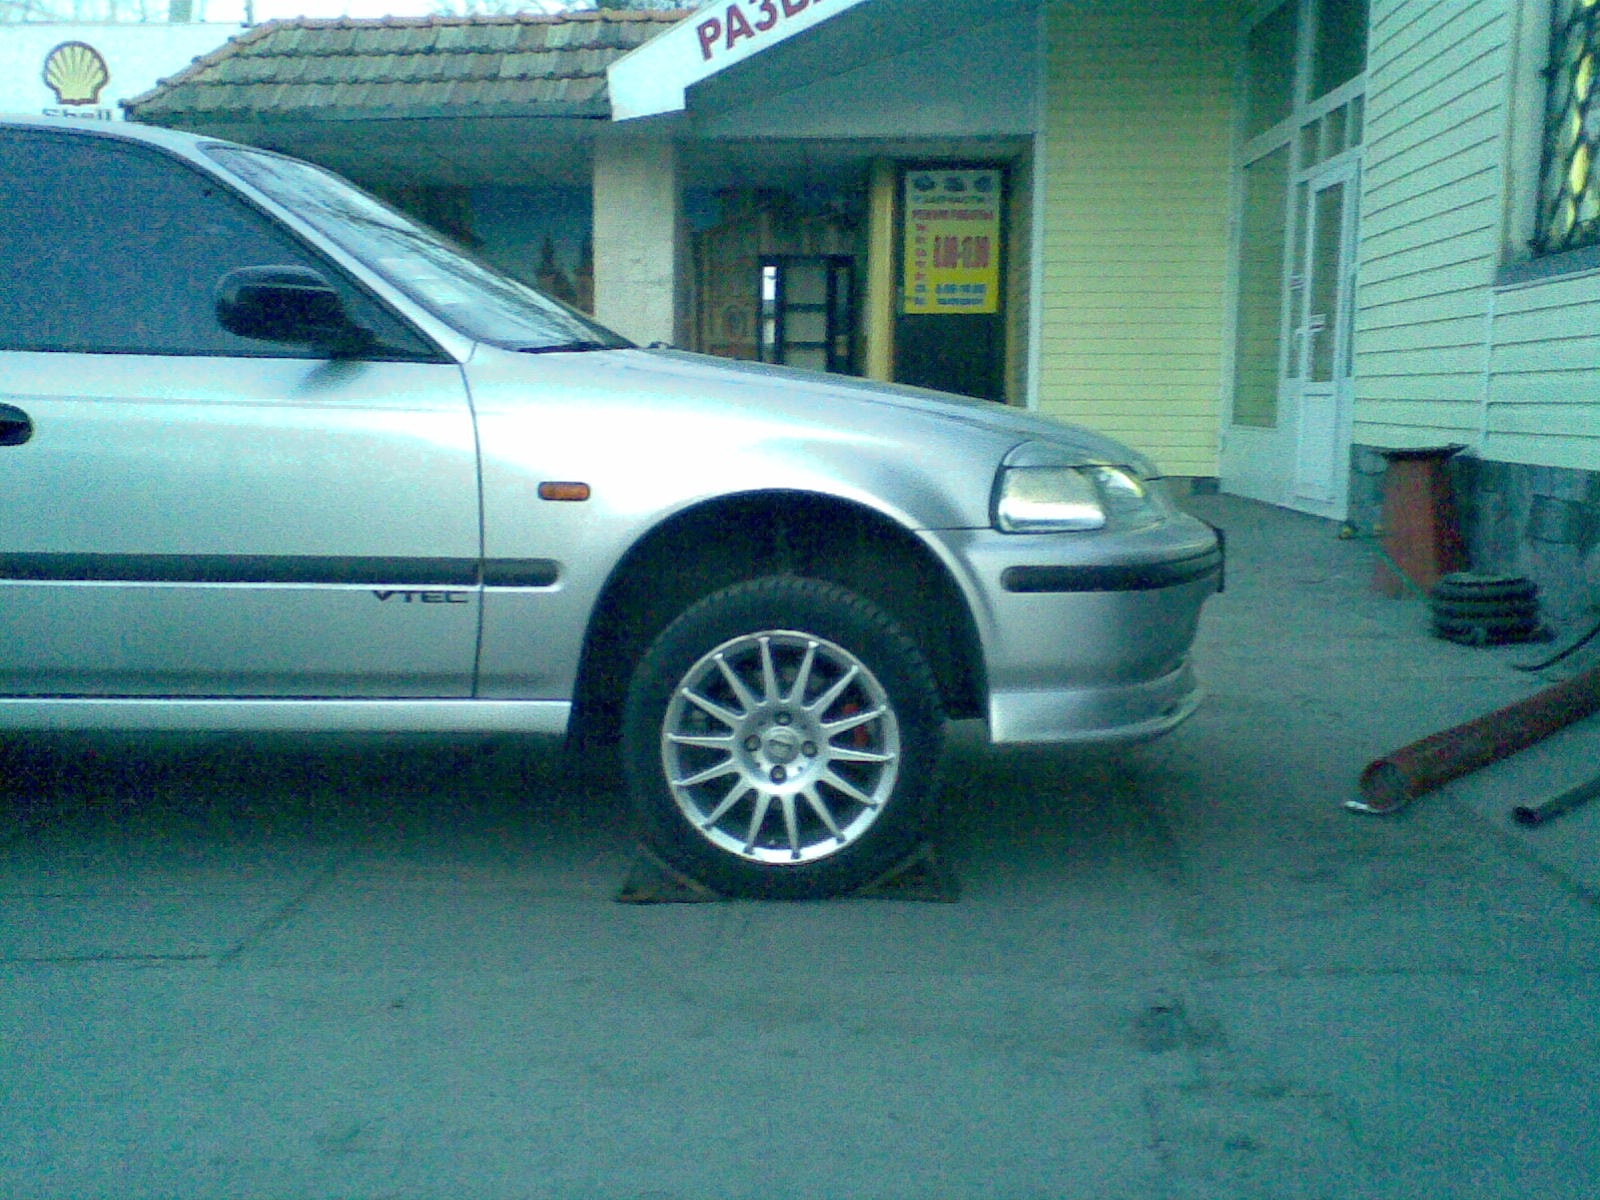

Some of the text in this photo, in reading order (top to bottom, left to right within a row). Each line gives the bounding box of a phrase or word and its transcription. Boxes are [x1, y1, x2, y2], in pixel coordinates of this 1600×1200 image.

[696, 0, 824, 61] РАЗ
[41, 108, 112, 121] Shell
[372, 590, 468, 603] VTEC
